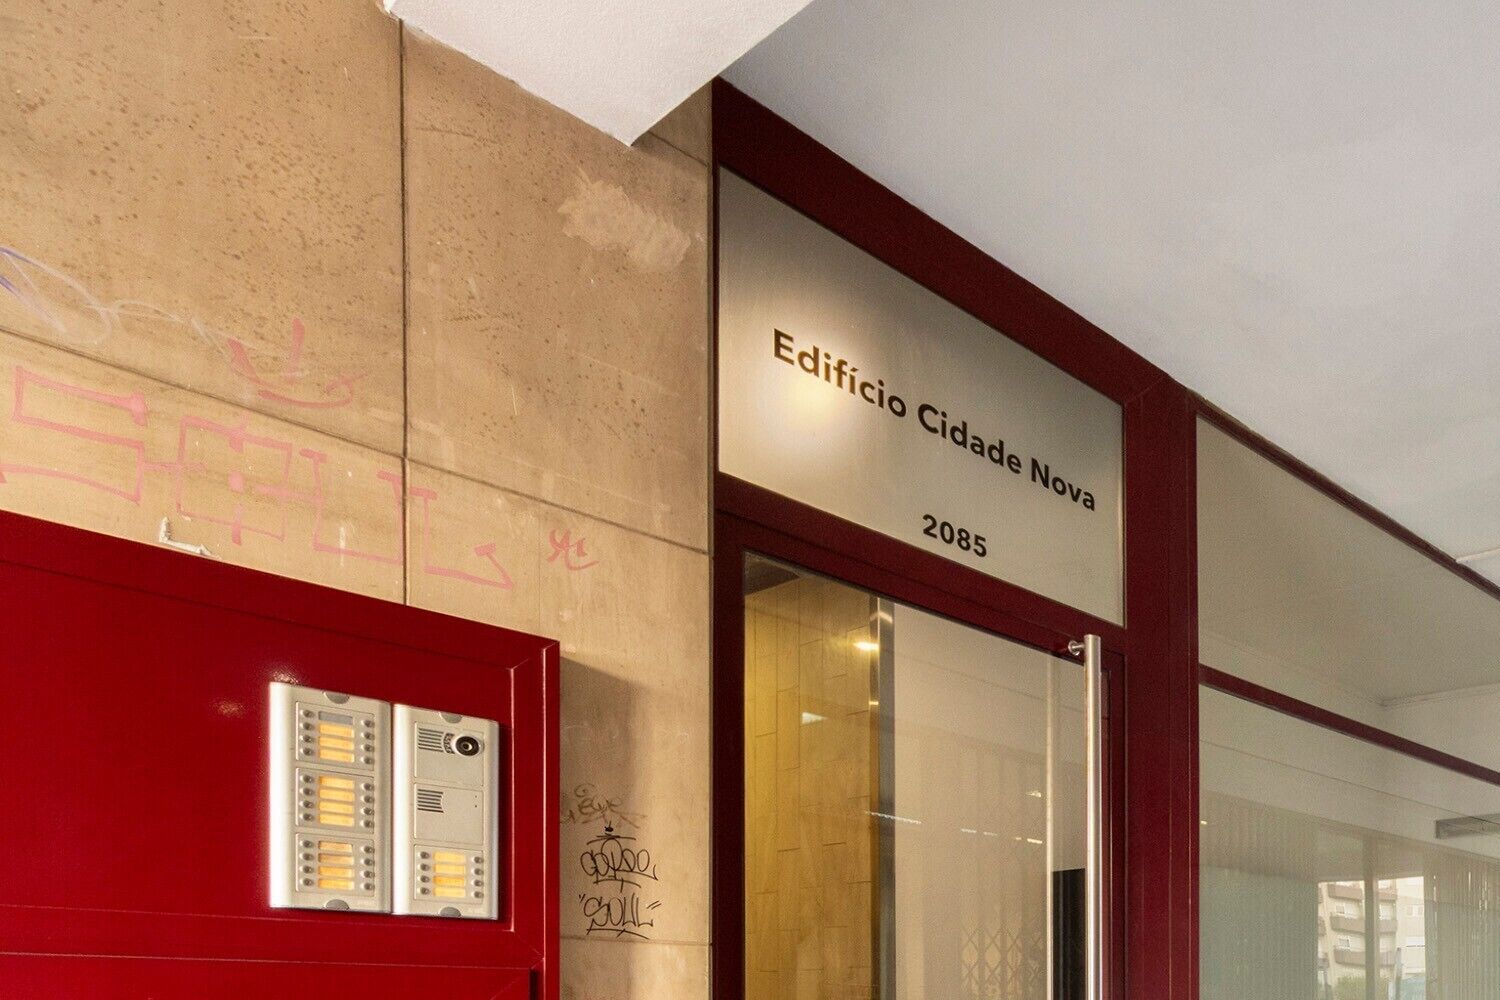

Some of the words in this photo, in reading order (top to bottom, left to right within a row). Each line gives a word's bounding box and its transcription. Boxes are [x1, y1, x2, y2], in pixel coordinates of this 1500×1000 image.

[773, 328, 908, 418] Edifício
[917, 403, 1022, 475] Cidade
[1030, 458, 1096, 512] Nova
[922, 513, 988, 558] 2085
